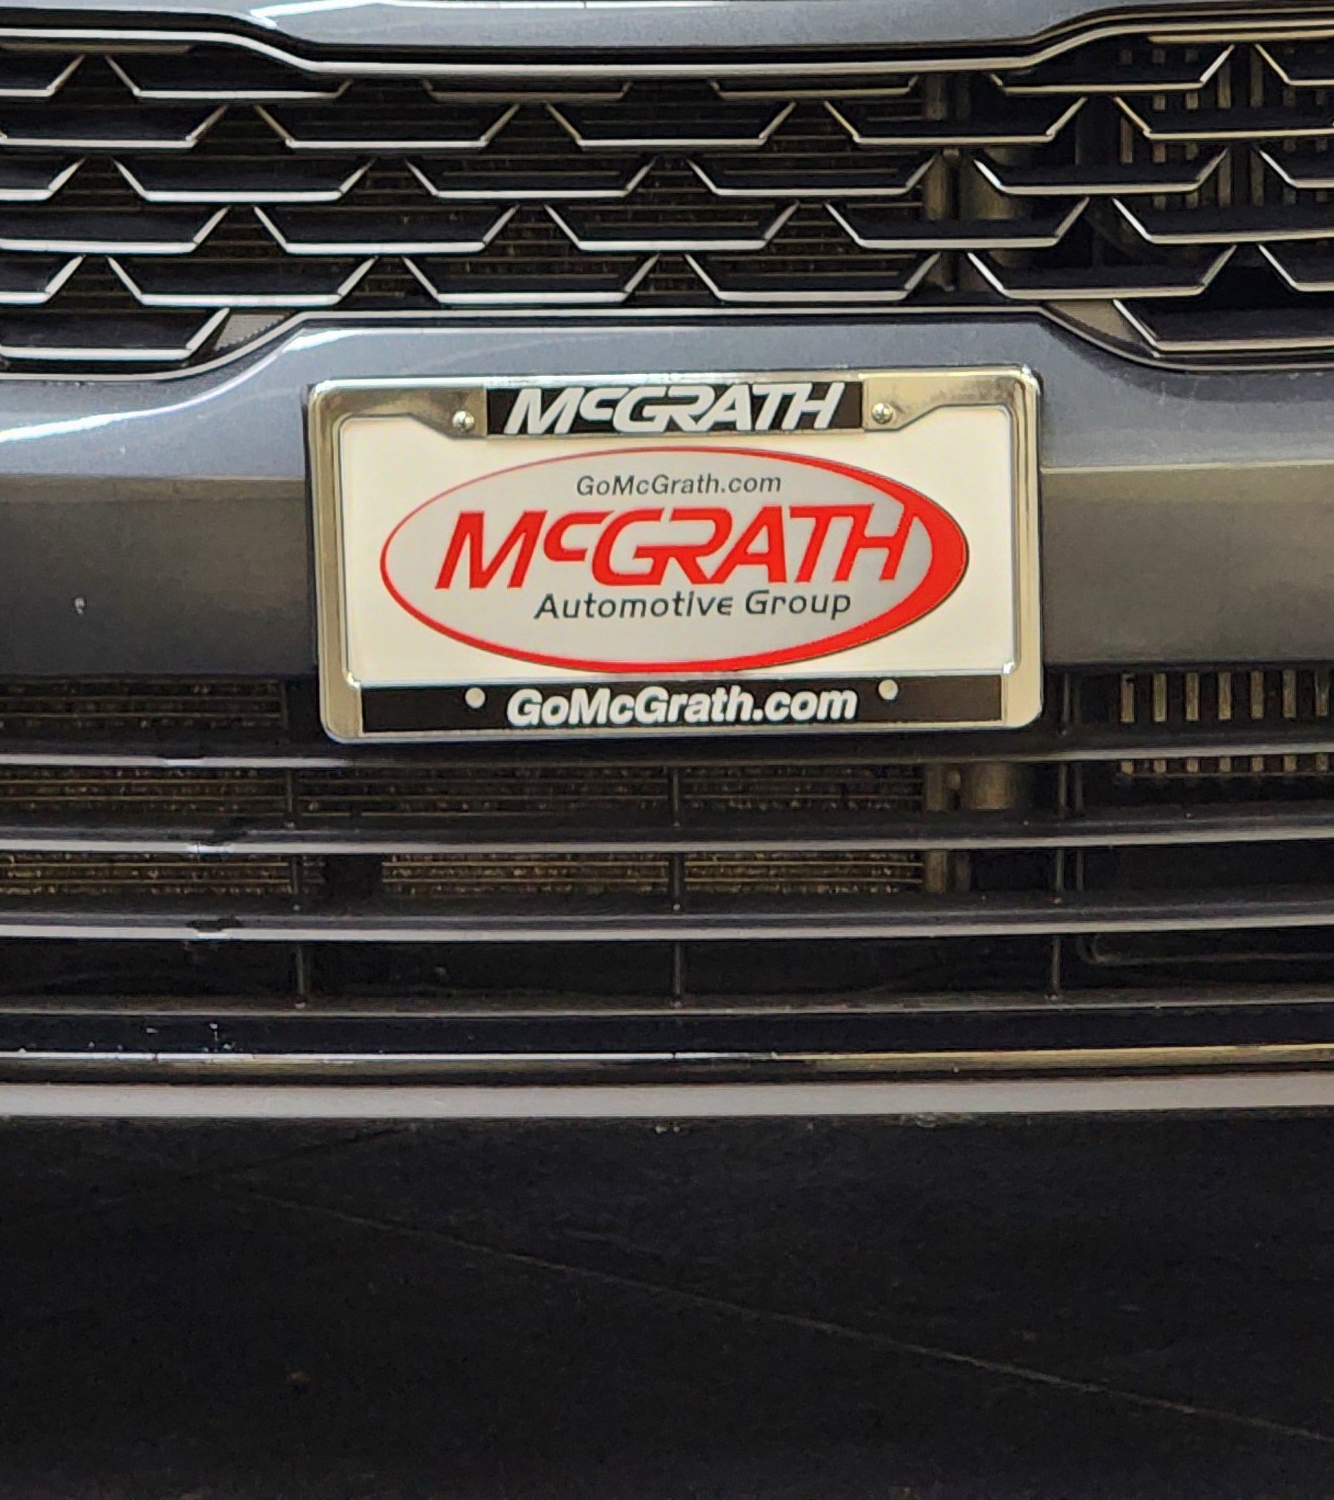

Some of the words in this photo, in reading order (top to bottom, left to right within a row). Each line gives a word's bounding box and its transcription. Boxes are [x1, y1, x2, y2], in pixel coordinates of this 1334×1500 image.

[576, 473, 782, 496] GoMcGrath.com
[534, 591, 733, 619] Automotive
[745, 589, 852, 620] Group
[507, 686, 857, 726] GoMcGrath.com
